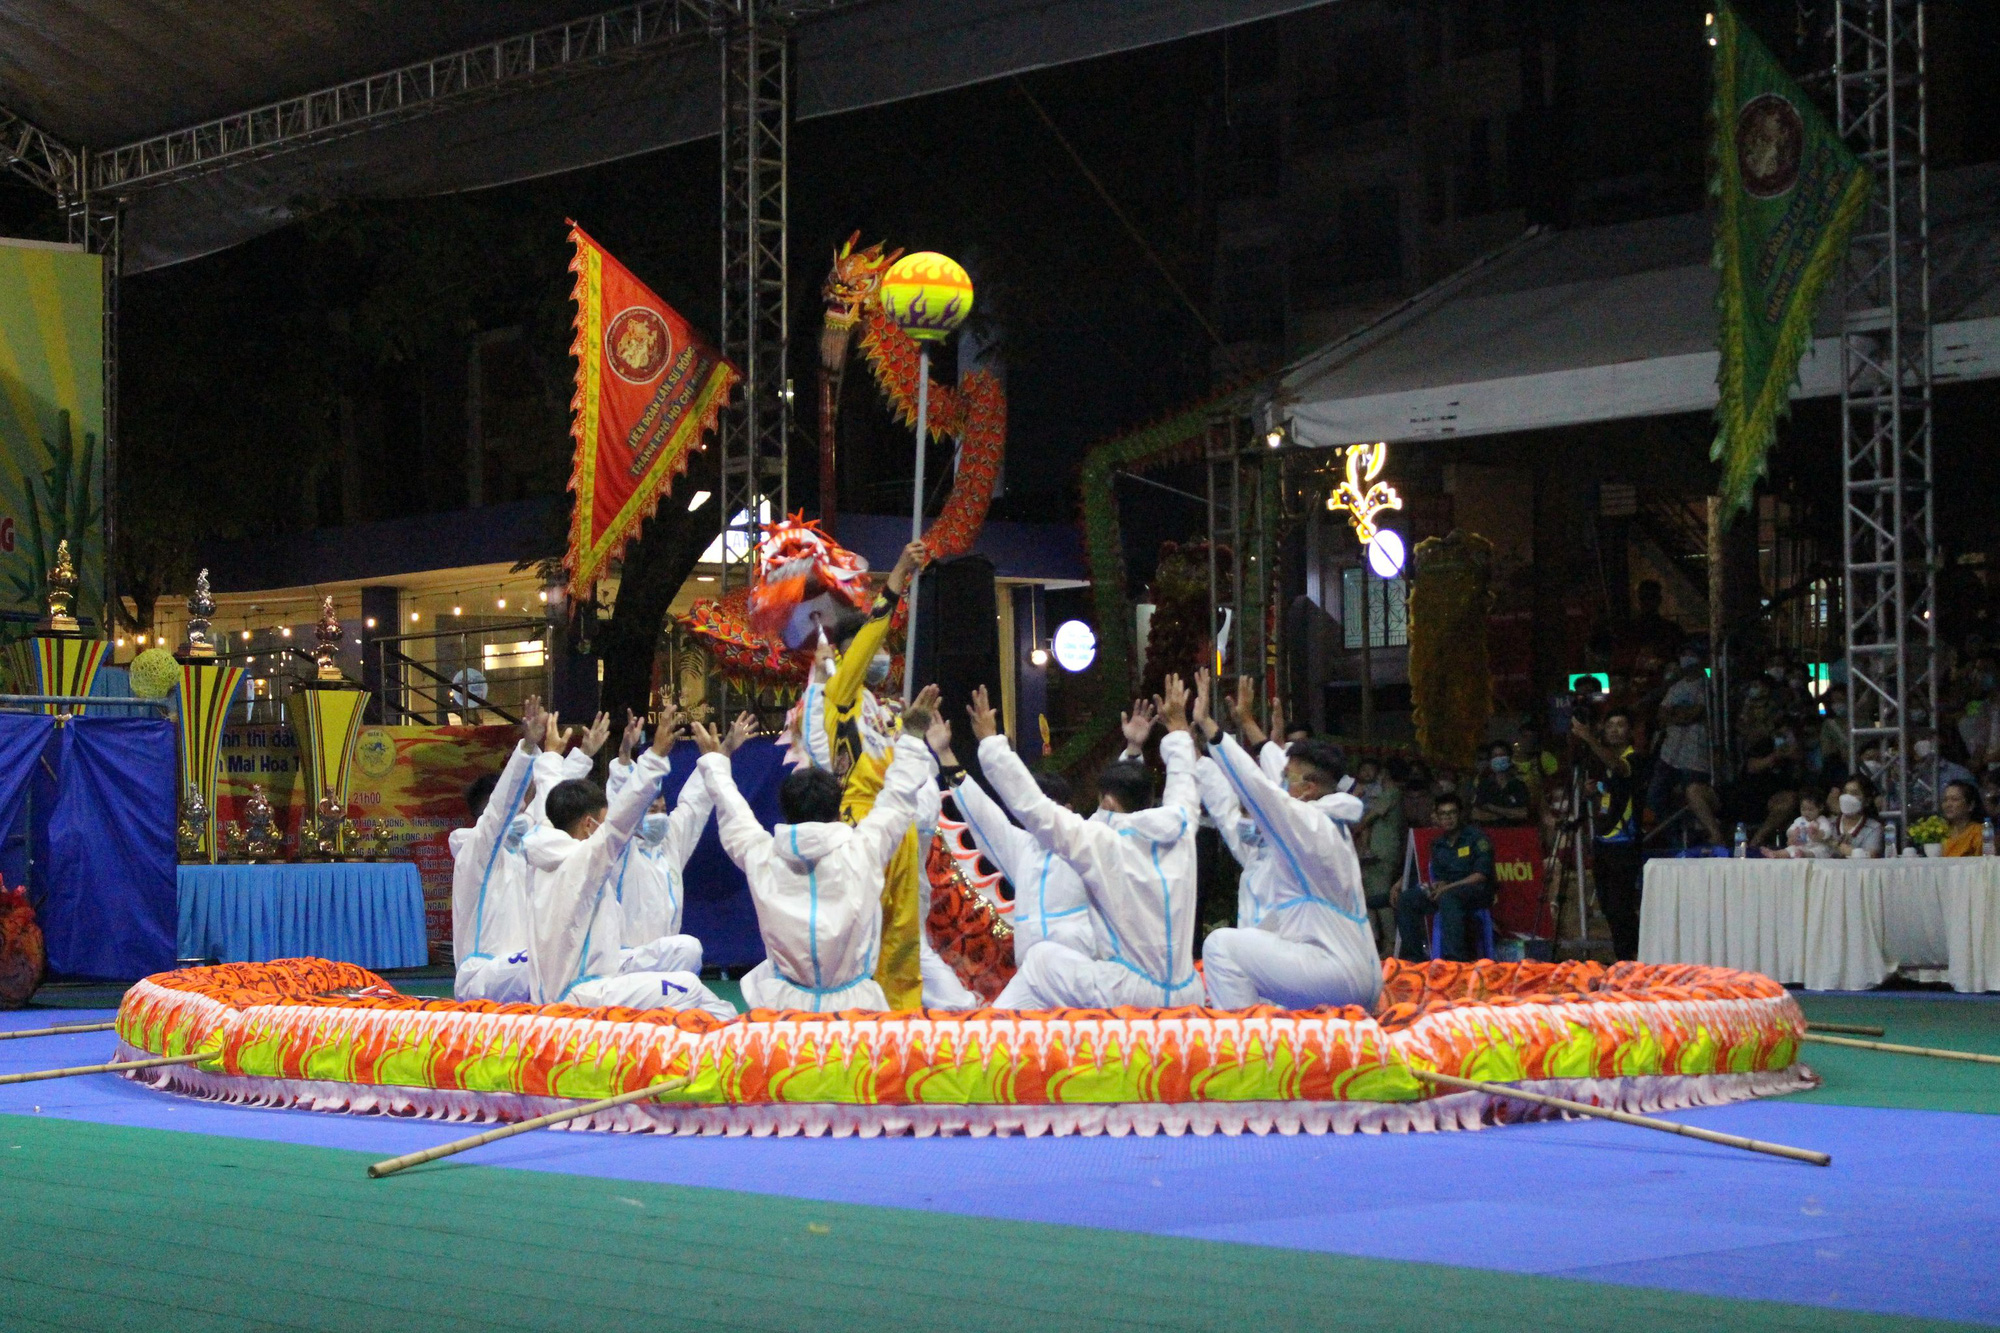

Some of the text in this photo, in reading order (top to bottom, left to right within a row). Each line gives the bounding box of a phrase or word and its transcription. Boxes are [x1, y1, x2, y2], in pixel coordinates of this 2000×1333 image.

[222, 730, 241, 747] nh
[247, 729, 266, 747] thi
[228, 755, 255, 772] Mai
[261, 755, 288, 772] Hoa
[353, 792, 381, 804] 21h00
[402, 832, 420, 841] LONG
[424, 832, 433, 841] AN
